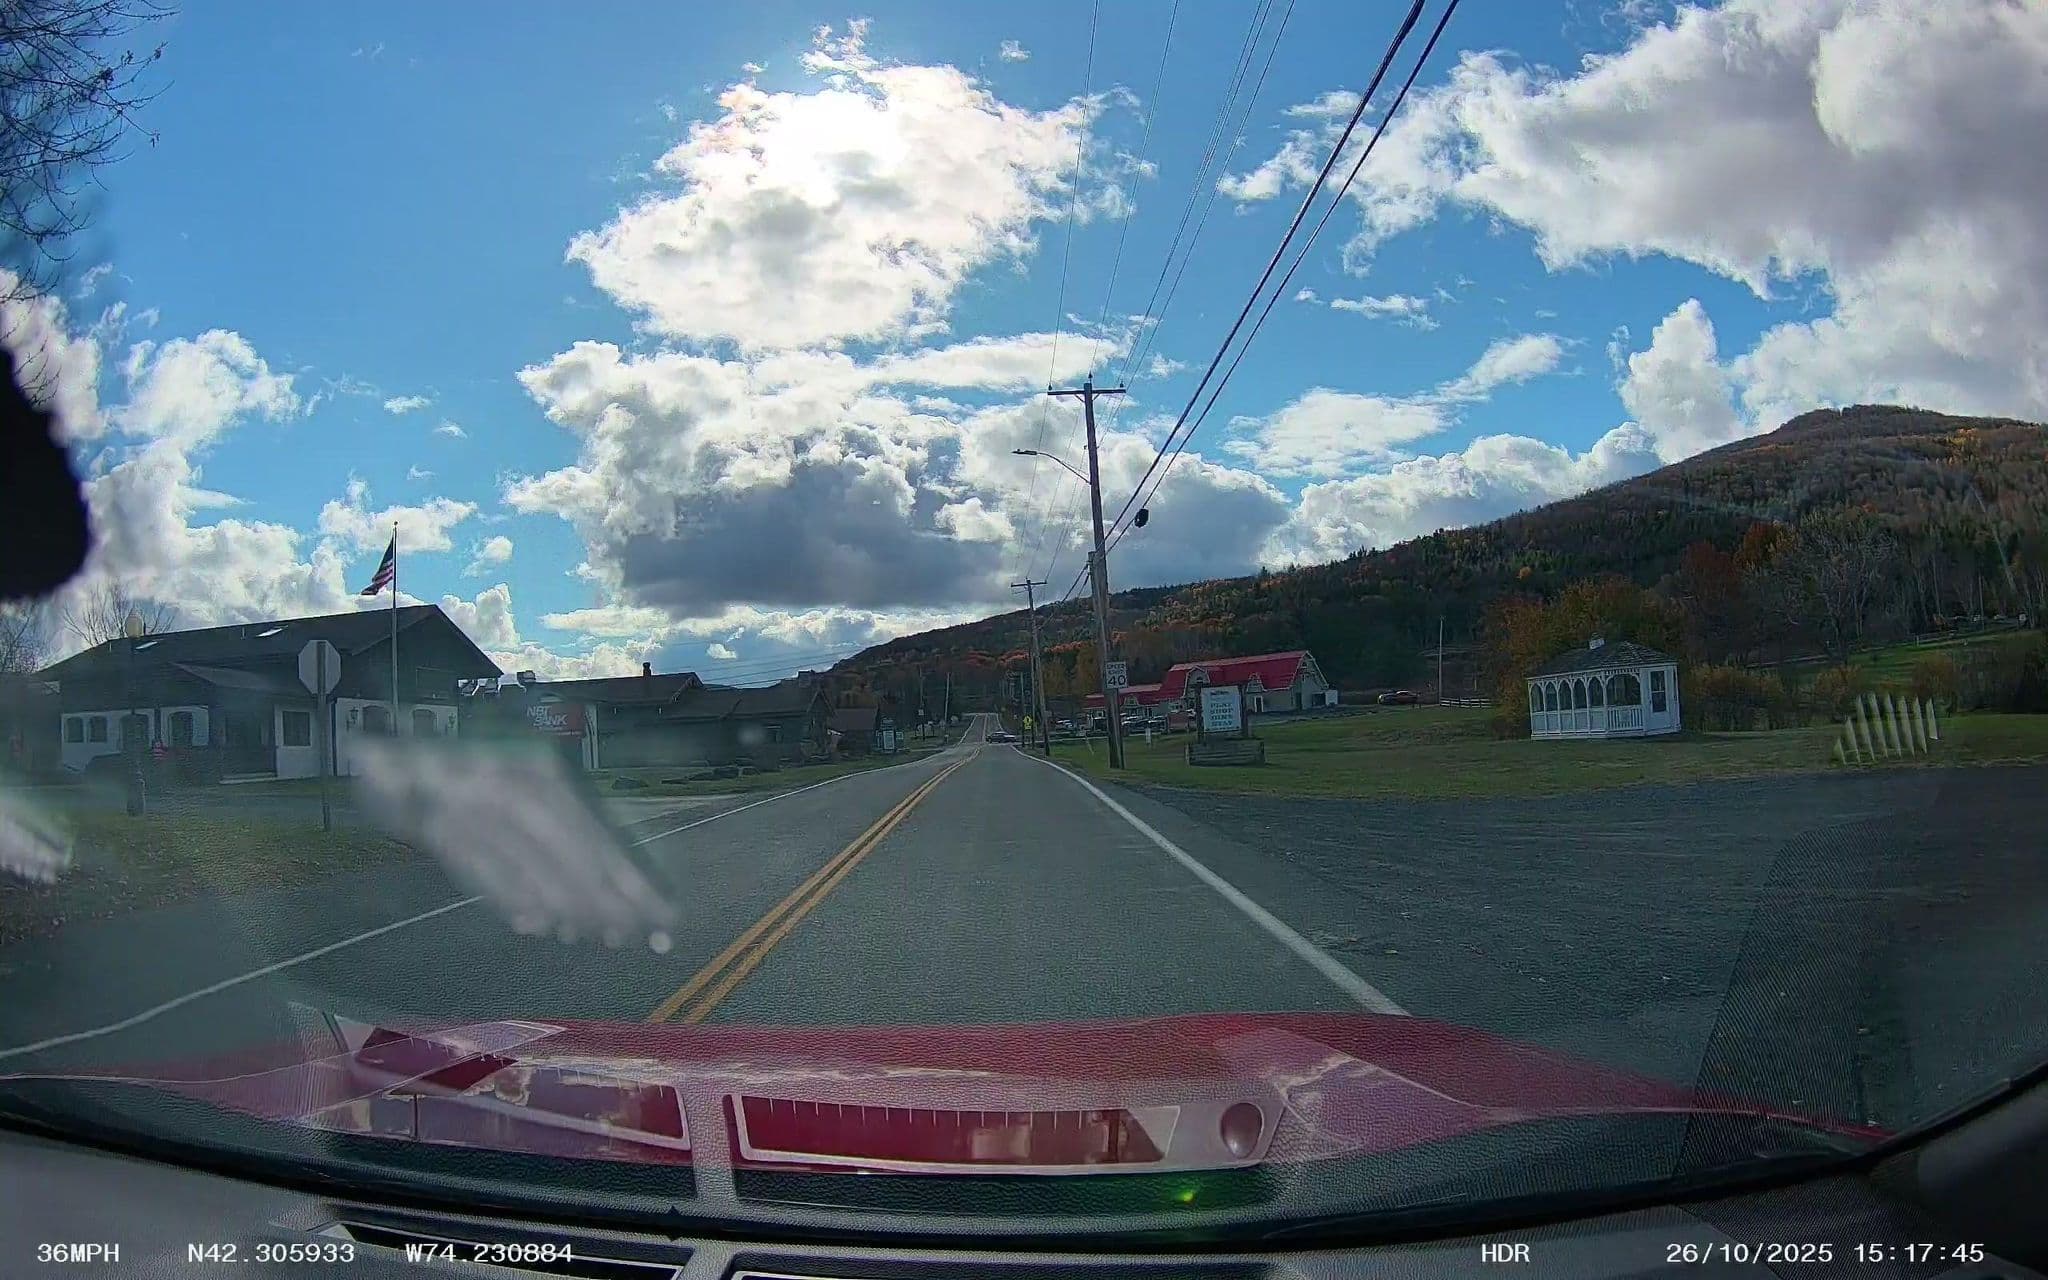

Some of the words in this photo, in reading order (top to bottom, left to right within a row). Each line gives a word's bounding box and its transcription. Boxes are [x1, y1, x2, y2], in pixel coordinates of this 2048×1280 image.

[1107, 675, 1126, 686] 40
[526, 705, 552, 717] NBT
[533, 714, 568, 726] BANK
